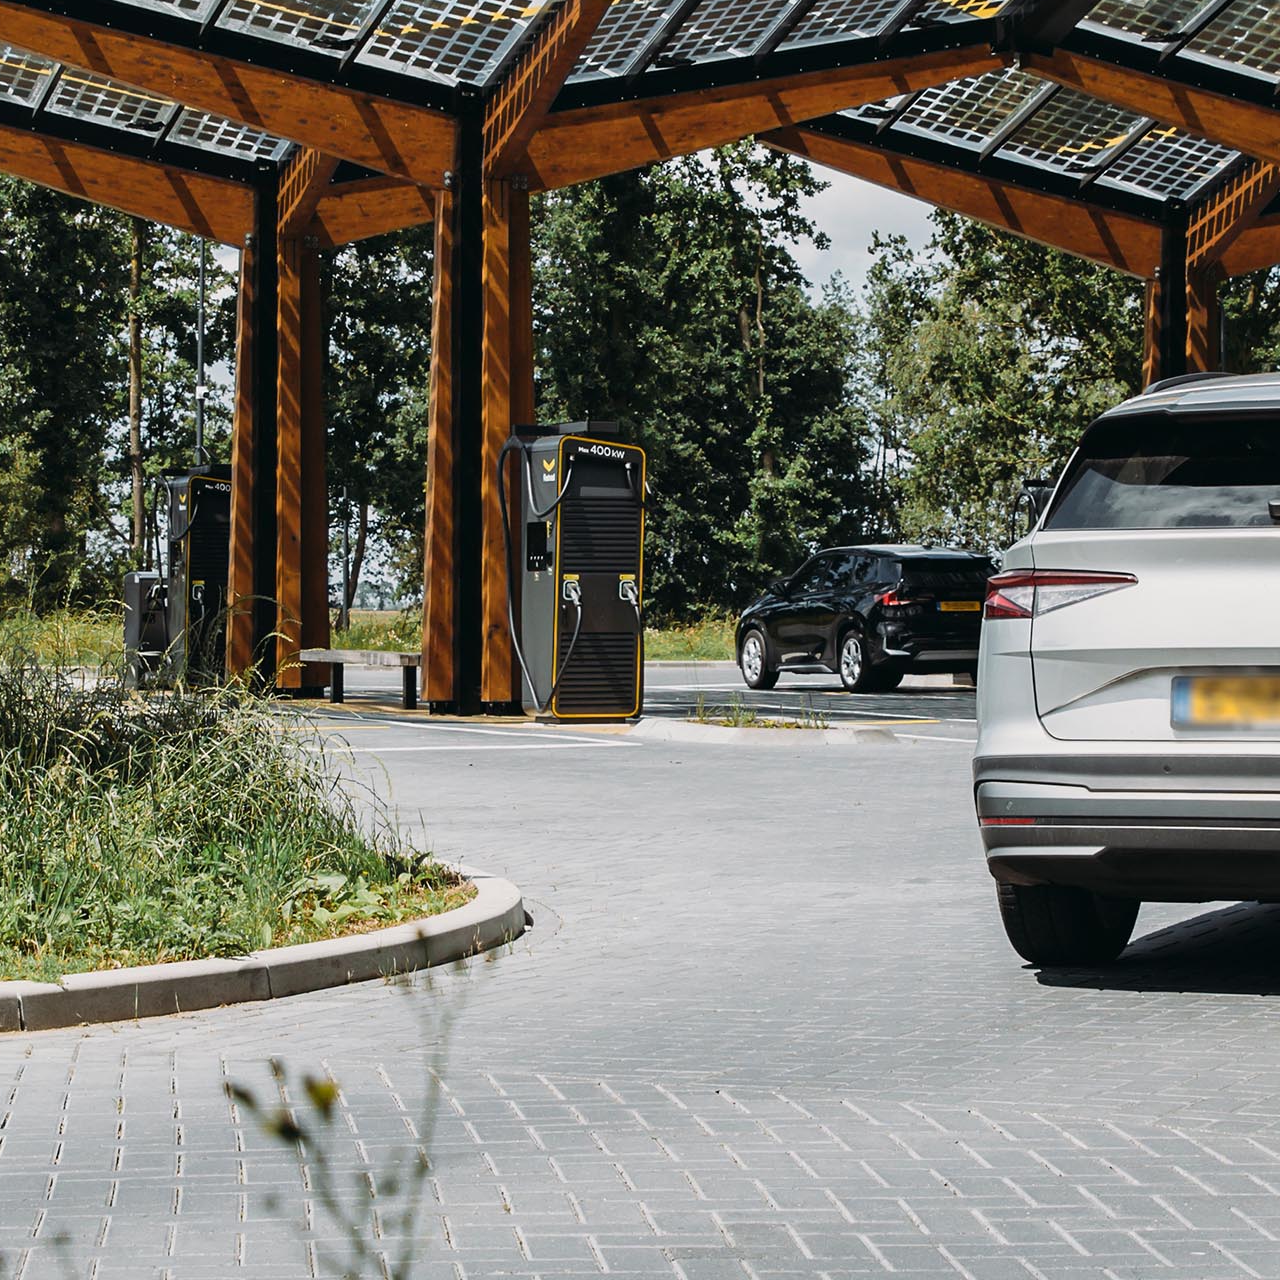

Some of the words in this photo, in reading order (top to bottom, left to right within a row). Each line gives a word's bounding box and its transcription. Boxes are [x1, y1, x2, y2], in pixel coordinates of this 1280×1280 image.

[590, 444, 611, 457] 400
[611, 449, 625, 459] kW
[215, 483, 231, 492] 400
